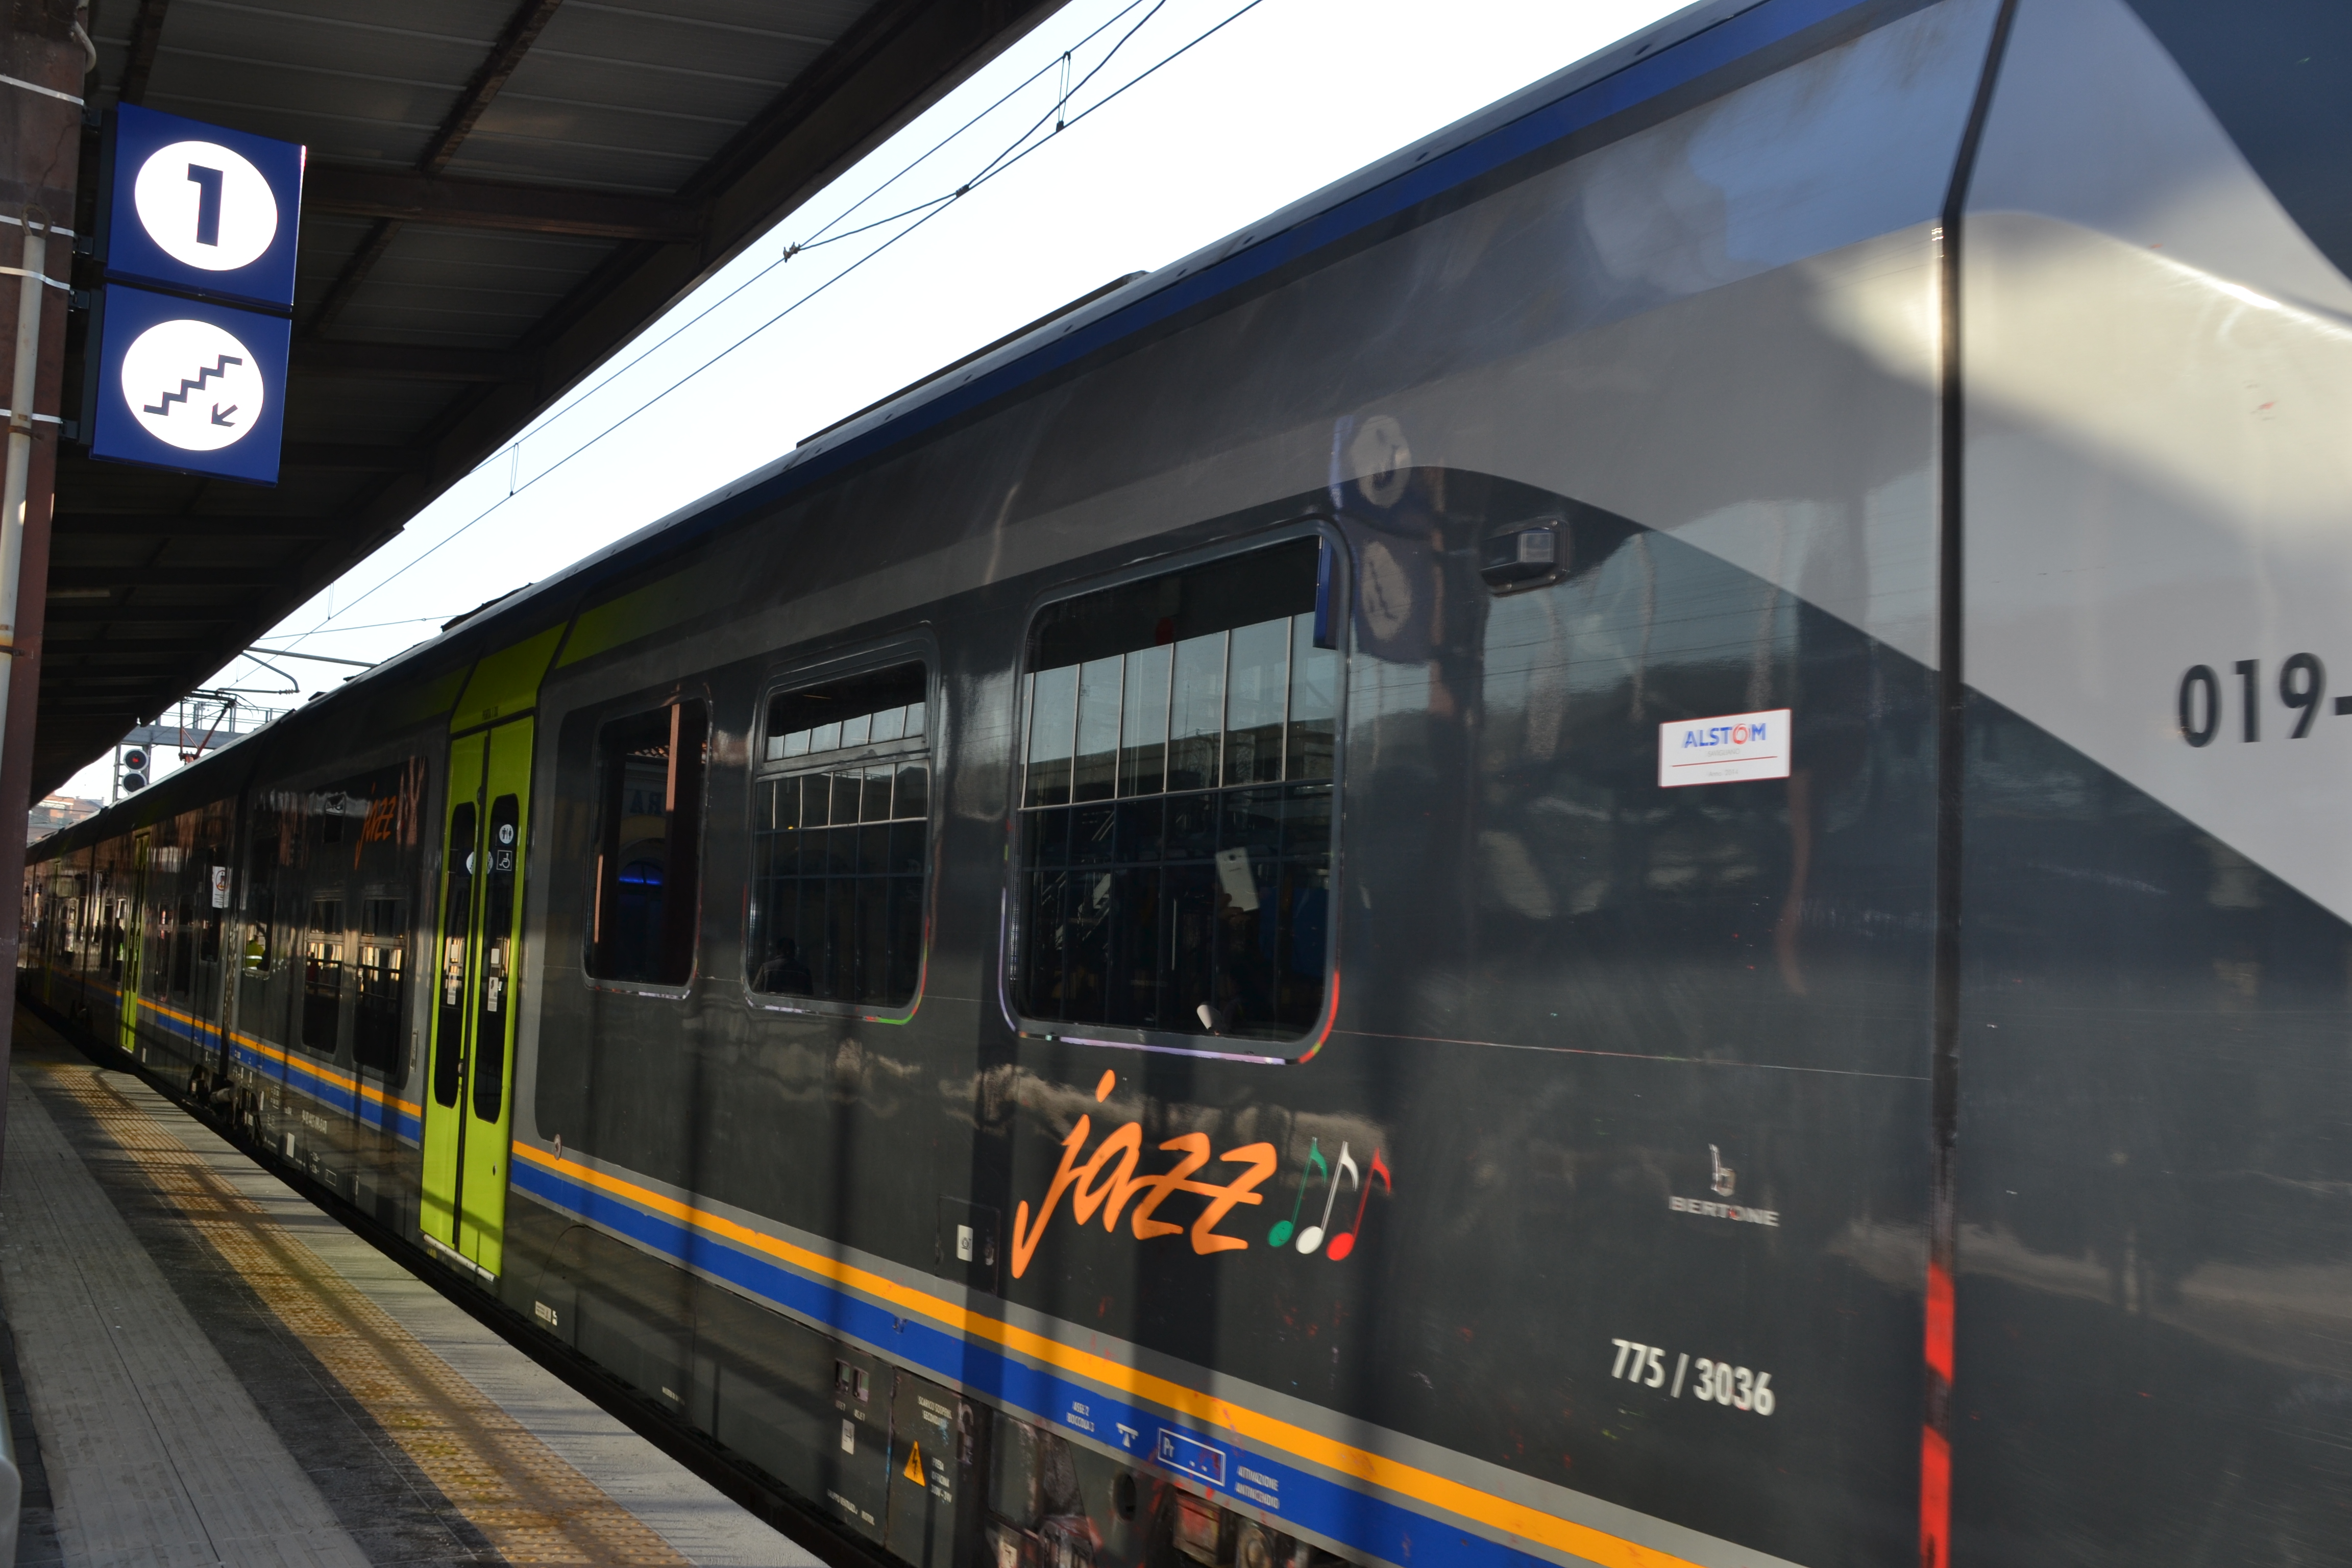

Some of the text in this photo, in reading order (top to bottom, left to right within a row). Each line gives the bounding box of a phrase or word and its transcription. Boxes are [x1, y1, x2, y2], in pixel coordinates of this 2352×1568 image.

[187, 163, 224, 247] 1
[1682, 723, 1766, 749] ALSTOM
[1011, 1069, 1277, 1279] jazz
[1669, 1196, 1780, 1227] BERTONE
